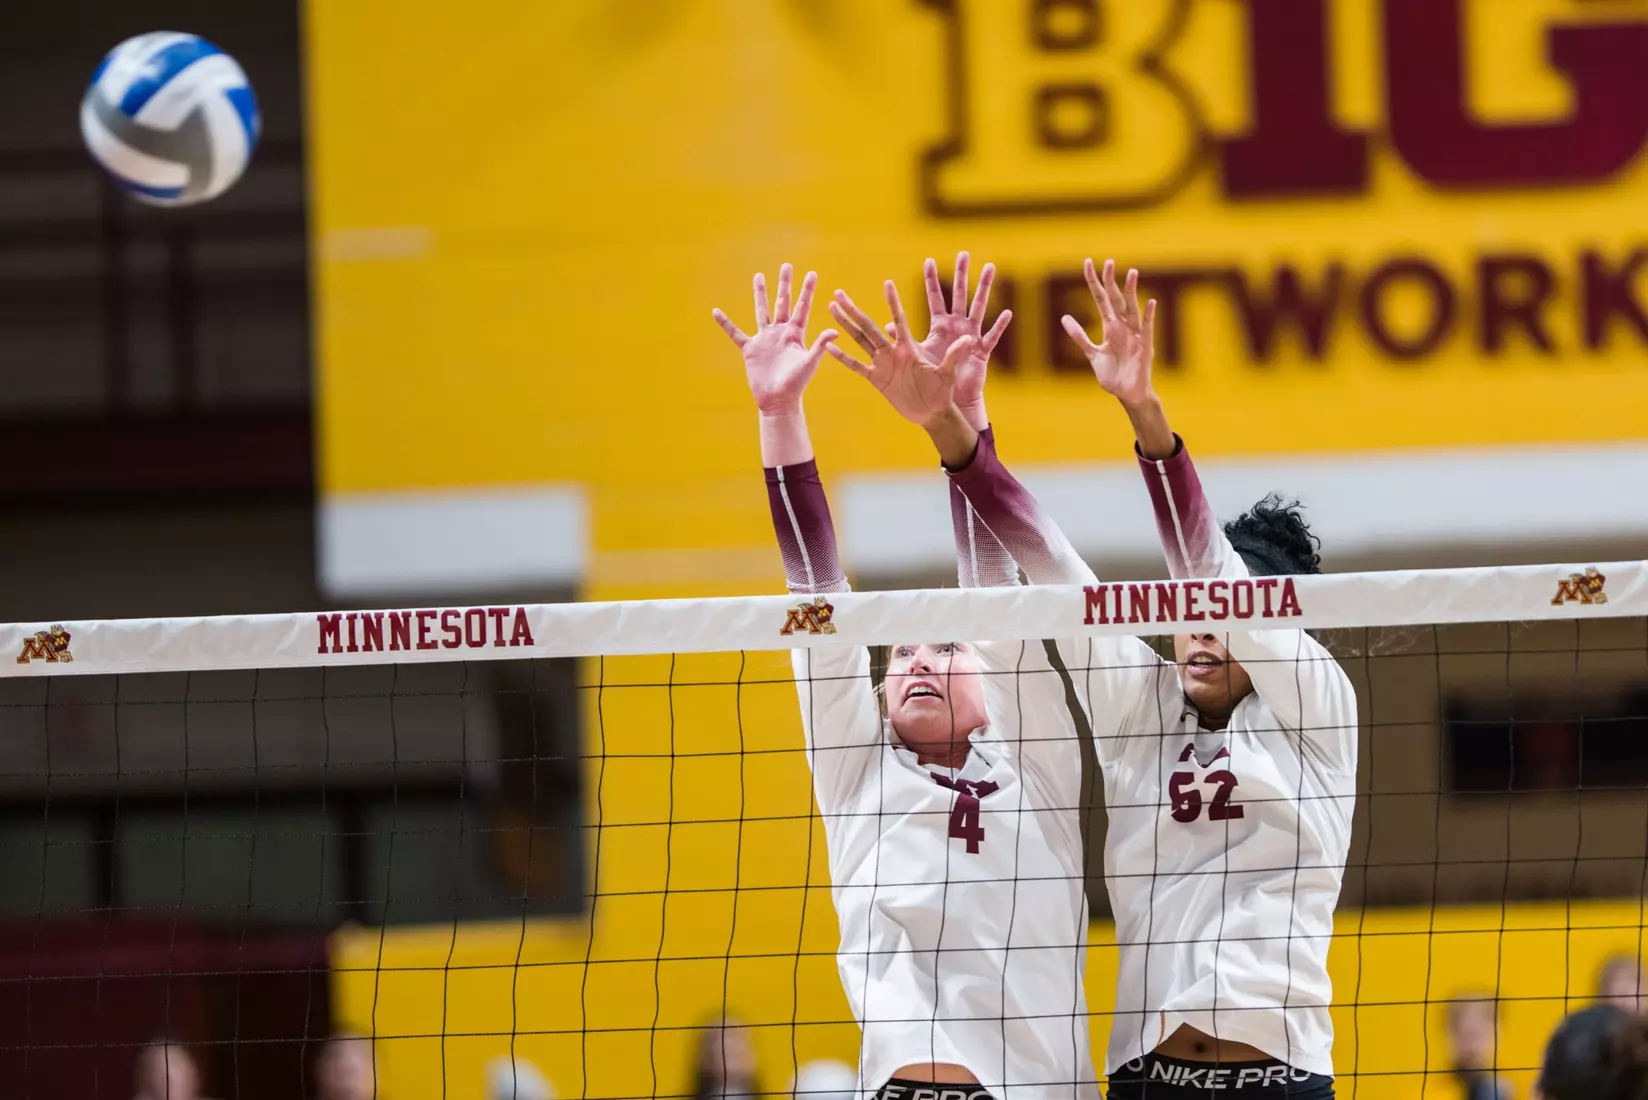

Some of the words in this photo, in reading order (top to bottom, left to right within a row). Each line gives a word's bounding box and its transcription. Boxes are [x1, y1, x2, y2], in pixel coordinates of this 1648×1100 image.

[1083, 577, 1303, 625] MINNESOTA
[317, 607, 535, 654] MINNESOTA
[1169, 769, 1244, 823] 52
[948, 793, 984, 854] 4
[1150, 1060, 1231, 1089] NIKE
[1235, 1065, 1311, 1089] PRO
